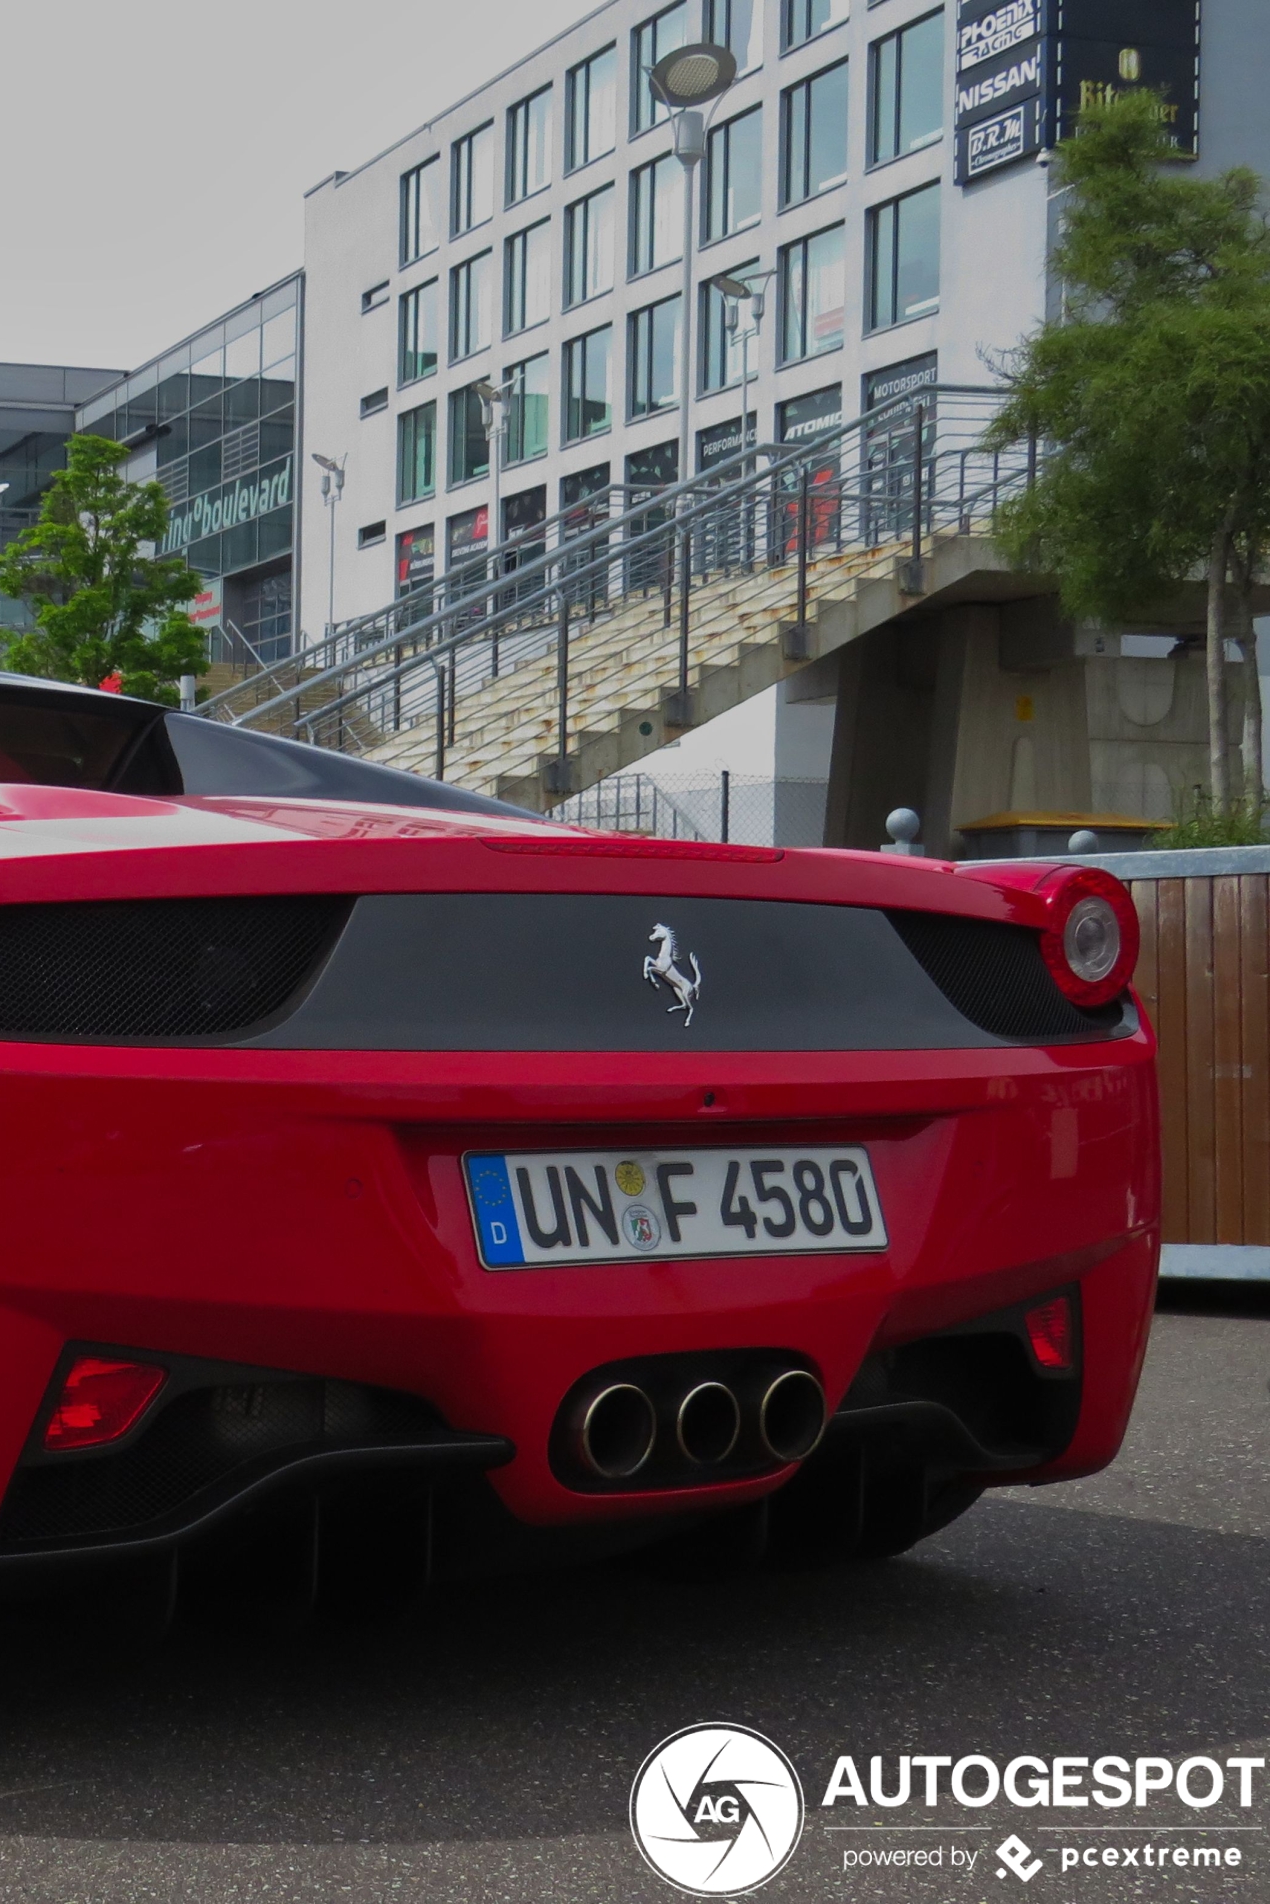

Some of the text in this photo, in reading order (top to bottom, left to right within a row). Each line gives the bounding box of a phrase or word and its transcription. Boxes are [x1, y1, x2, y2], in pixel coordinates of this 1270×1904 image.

[959, 57, 1036, 114] NISSAN
[873, 367, 936, 399] MOTORSPORT
[515, 1165, 620, 1249] UN
[656, 1161, 698, 1243] F
[719, 1158, 873, 1239] 4580
[492, 1221, 508, 1245] D
